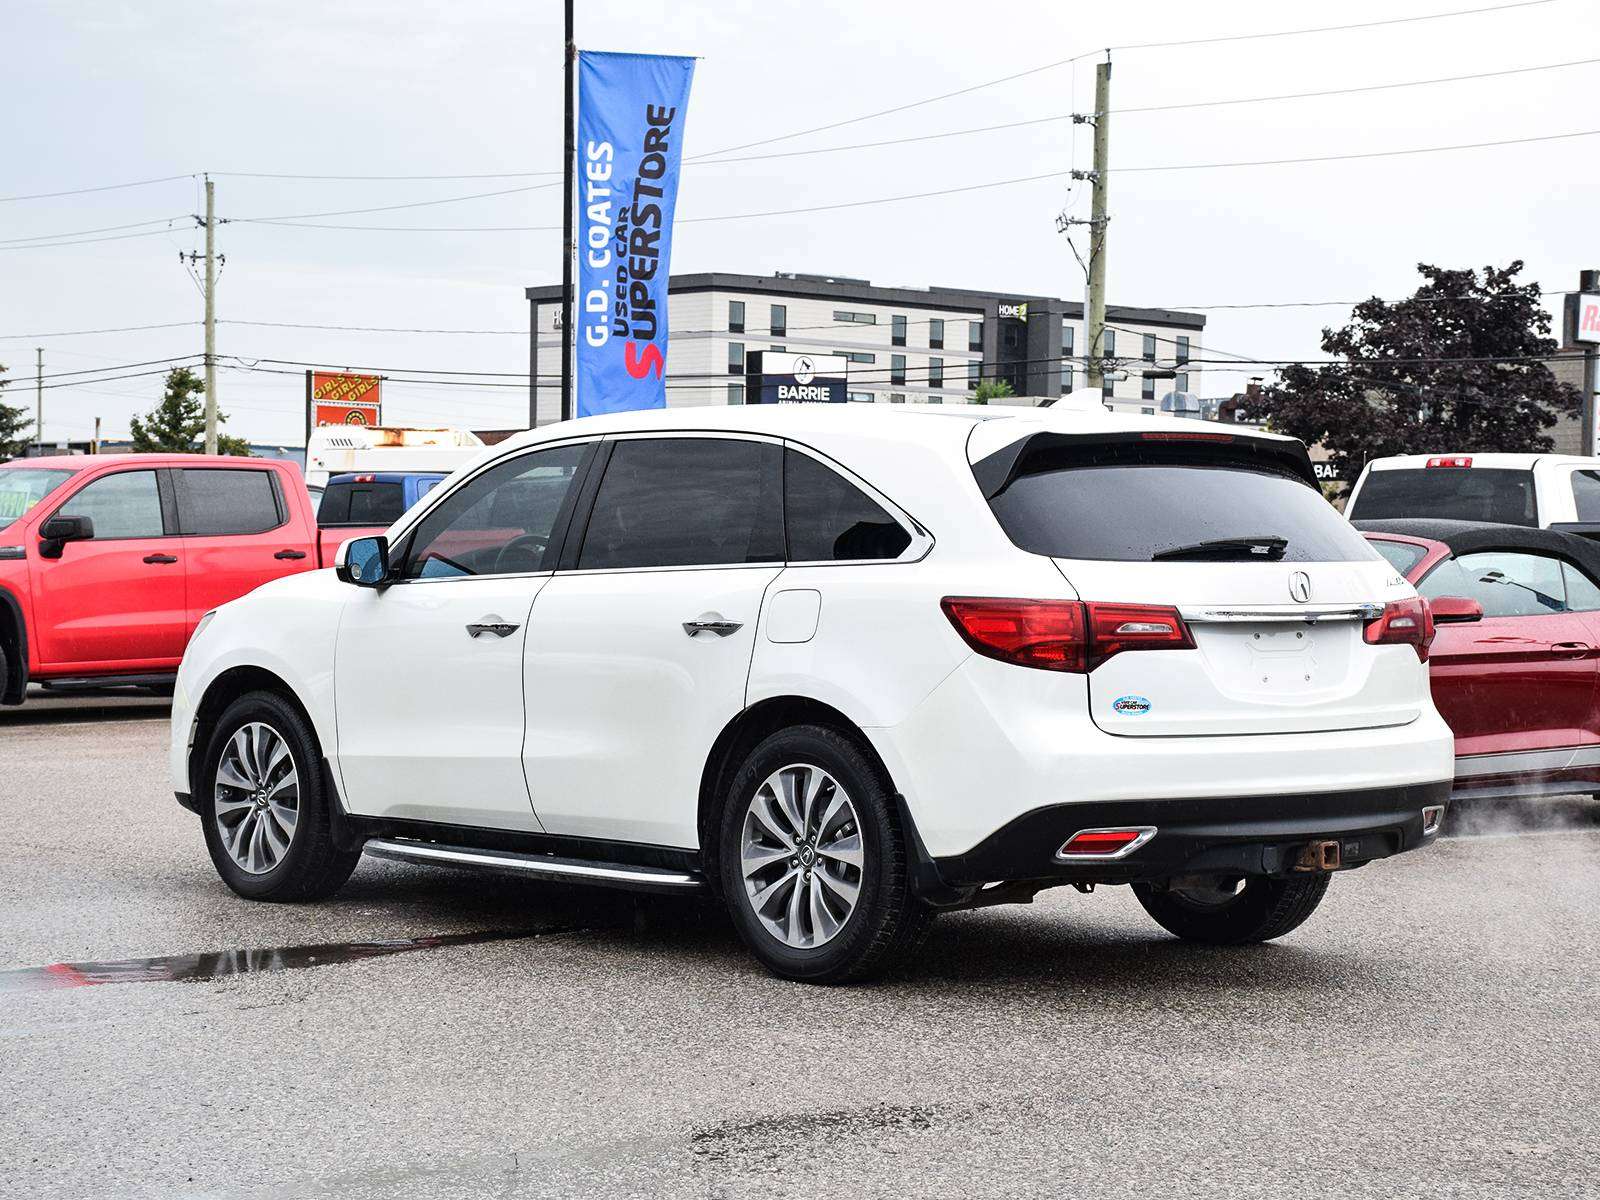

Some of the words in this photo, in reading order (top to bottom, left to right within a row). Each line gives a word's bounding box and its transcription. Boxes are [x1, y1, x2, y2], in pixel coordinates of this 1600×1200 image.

[587, 140, 615, 268] COATES
[615, 205, 631, 257] CAR
[625, 103, 676, 380] SUPERSTORE
[586, 280, 610, 347] G.D.
[612, 265, 630, 338] USED
[314, 373, 345, 399] GIRLS
[331, 374, 362, 400] GIRLS
[348, 376, 379, 401] GIRLS
[778, 385, 830, 401] BARRIE
